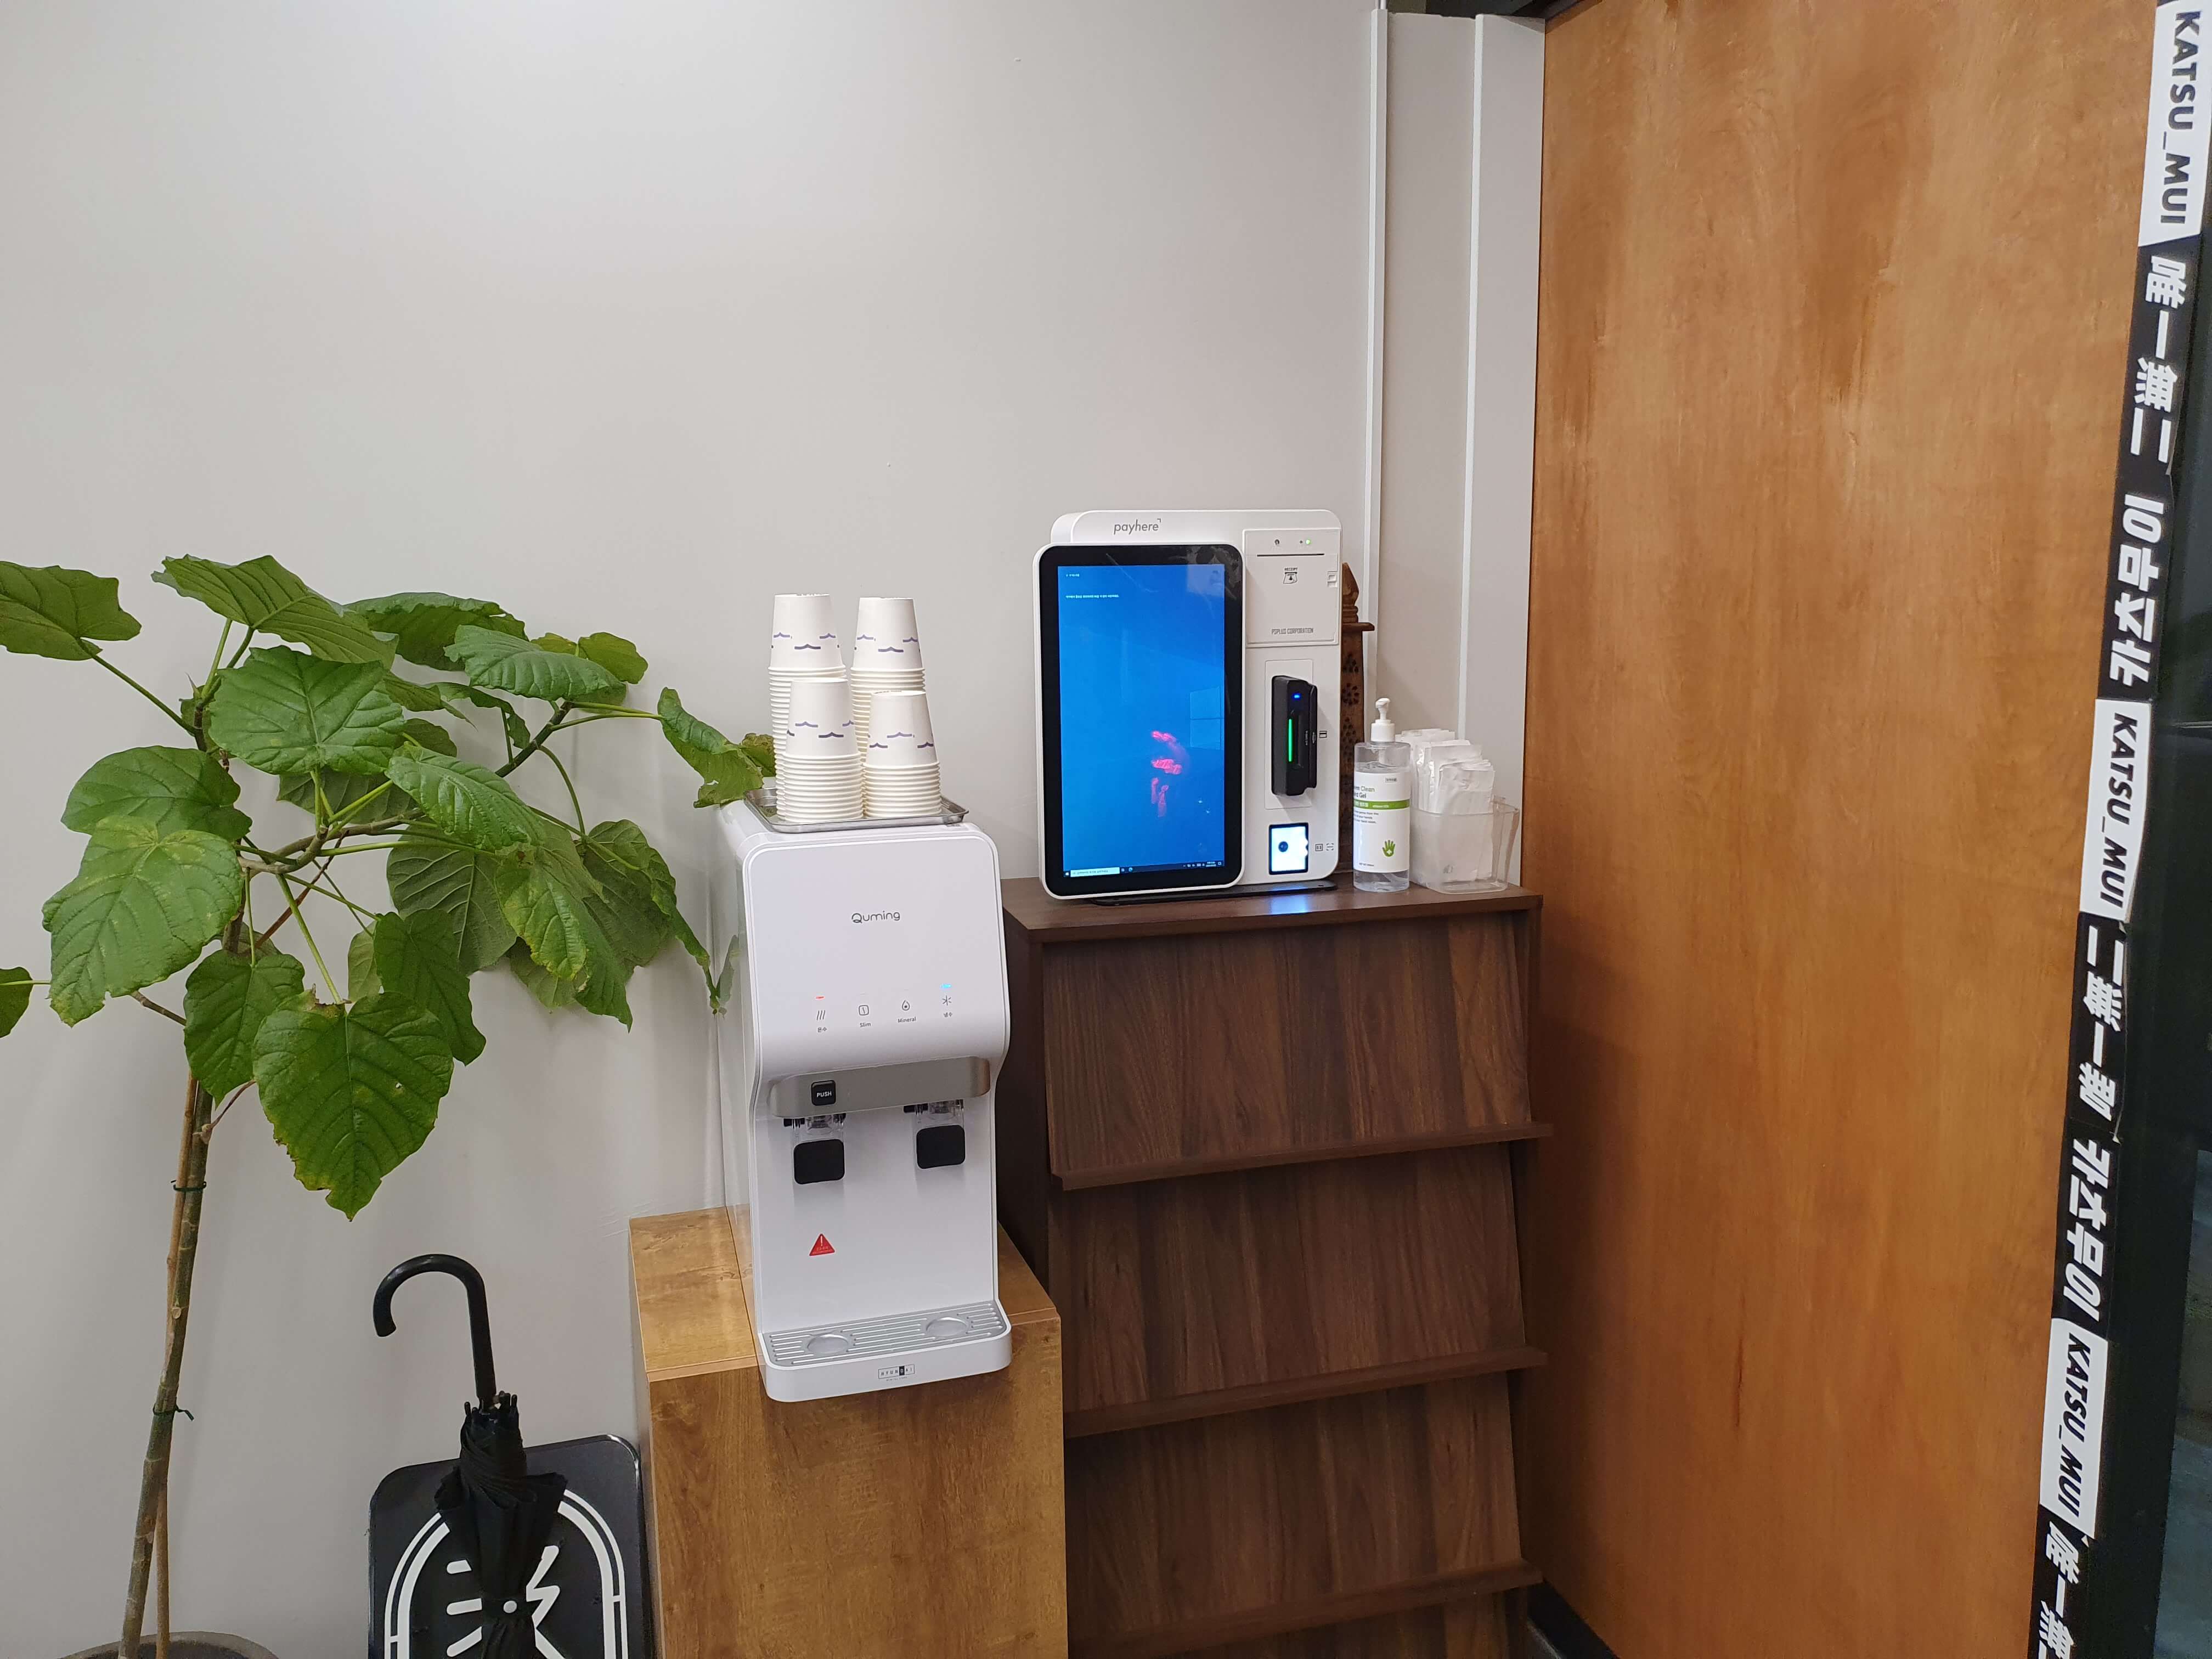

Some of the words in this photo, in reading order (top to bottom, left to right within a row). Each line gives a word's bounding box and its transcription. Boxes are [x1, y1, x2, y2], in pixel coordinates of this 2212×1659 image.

[2160, 10, 2201, 224] KATSU_MUI
[2131, 255, 2187, 463] 唯一無二
[1114, 518, 1159, 535] payhere
[2109, 493, 2164, 687] 카츠무이
[2100, 713, 2138, 909] KATSU_MUI
[851, 910, 900, 923] Quming
[2079, 926, 2125, 1121] 唯一無二
[2063, 1138, 2111, 1322] 카츠무이
[881, 1367, 912, 1376] HYUNDAI
[2057, 1333, 2091, 1517] KATSU_MUI
[2039, 1521, 2079, 1659] 唯一無
